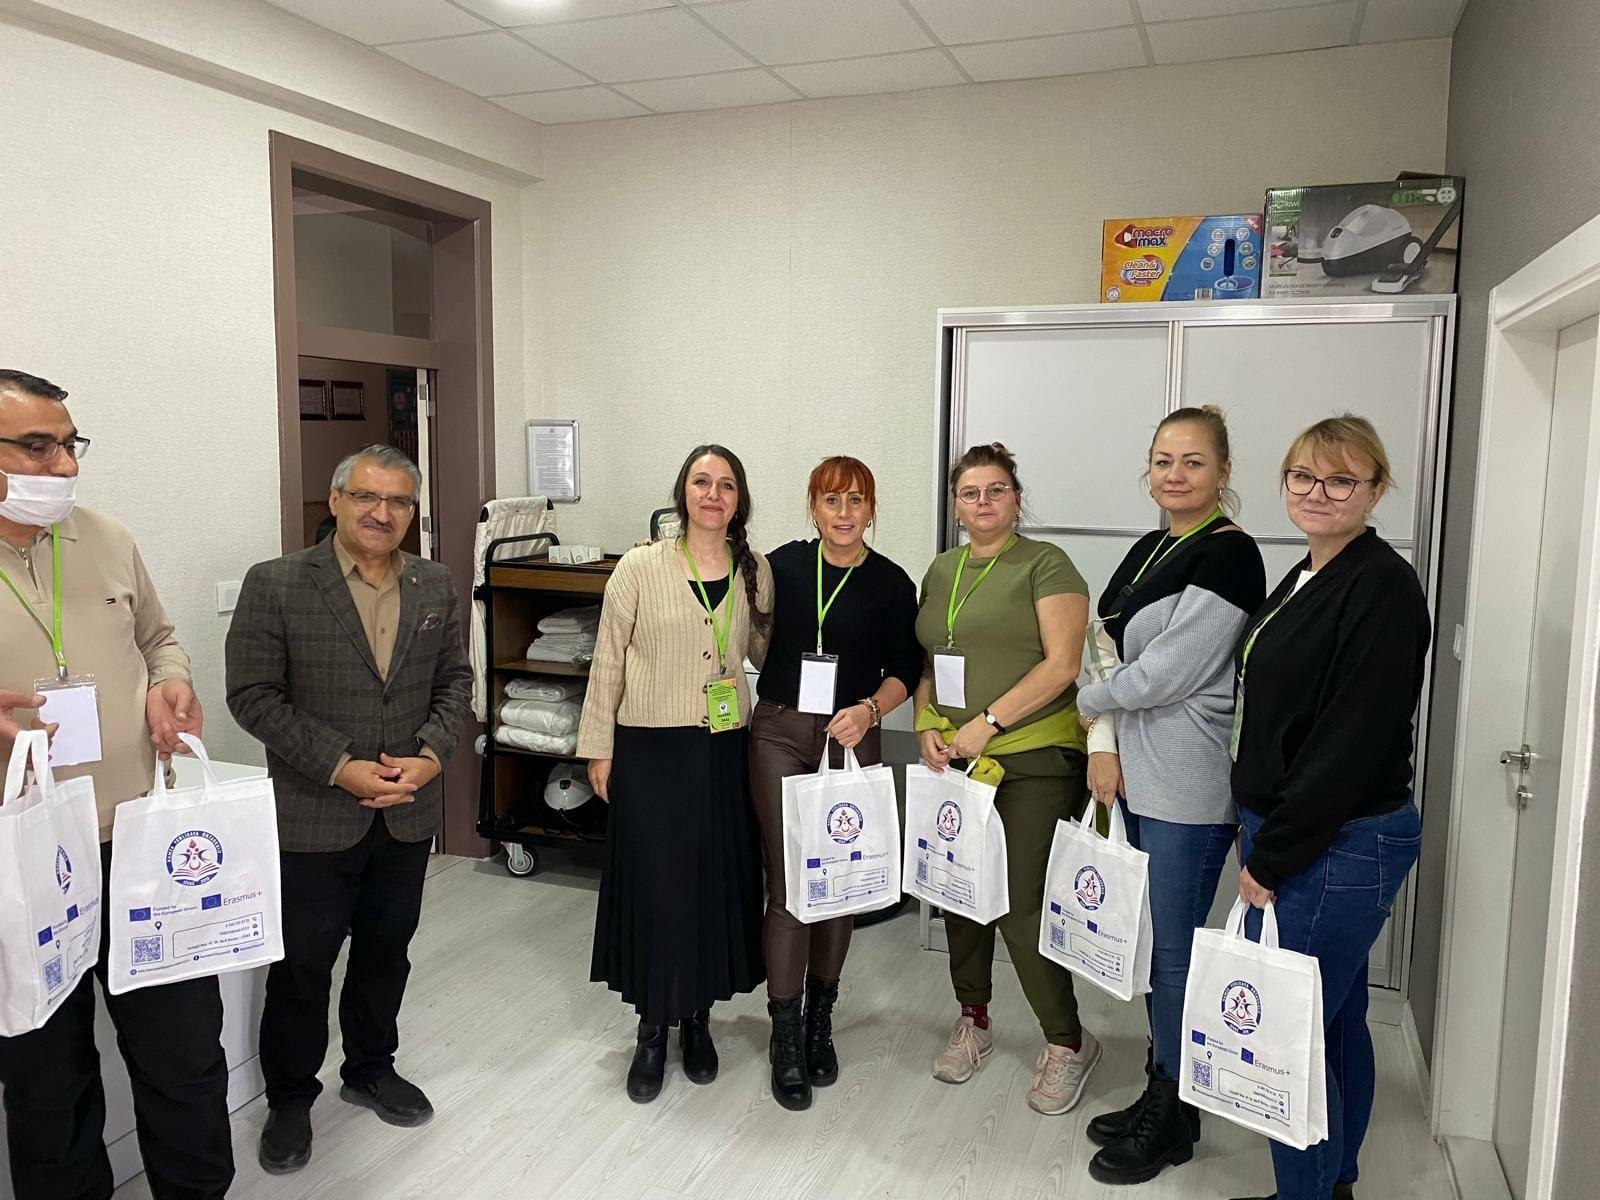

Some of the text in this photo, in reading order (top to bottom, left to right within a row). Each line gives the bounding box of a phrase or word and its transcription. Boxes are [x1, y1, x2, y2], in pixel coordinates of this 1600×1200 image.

[1132, 227, 1174, 238] macro
[1138, 237, 1166, 247] max
[1131, 270, 1161, 278] Faster
[224, 892, 256, 905] Erasmus
[1255, 1060, 1284, 1075] Erasmus
